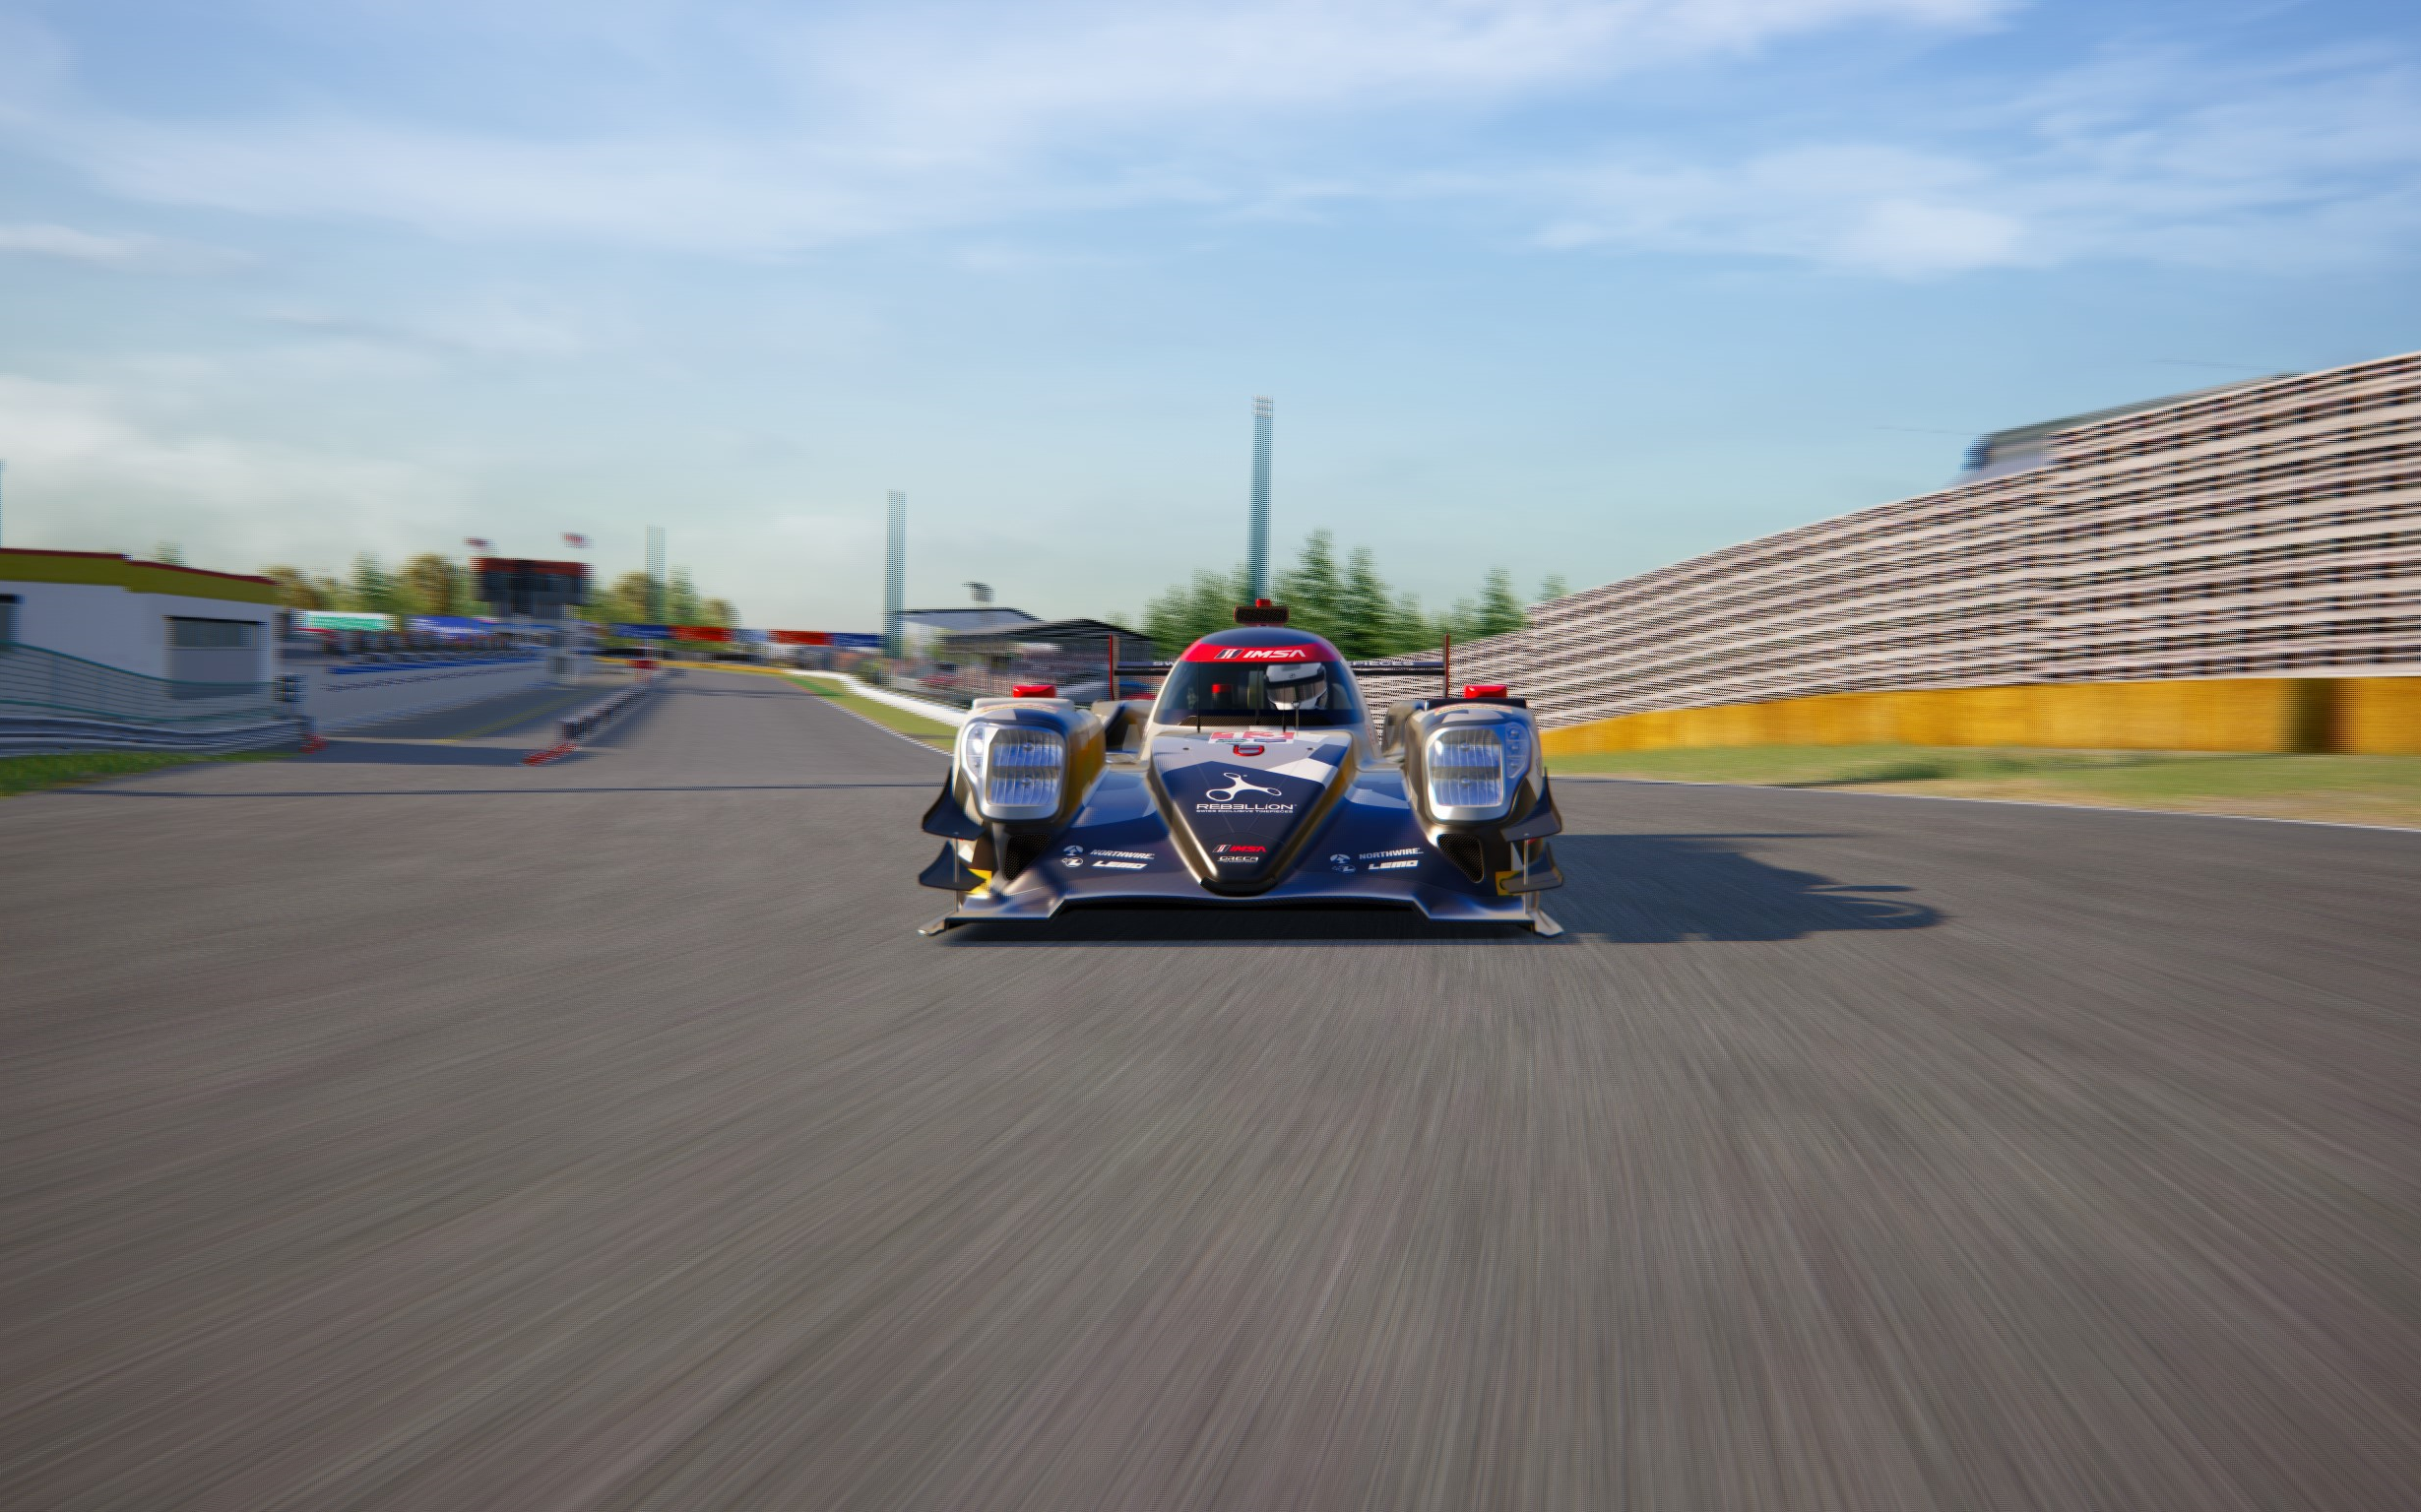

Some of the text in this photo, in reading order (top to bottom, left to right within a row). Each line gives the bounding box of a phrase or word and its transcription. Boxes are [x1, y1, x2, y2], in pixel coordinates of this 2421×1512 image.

[1242, 649, 1306, 659] IMSA
[1090, 849, 1153, 859] NORTHWIRE
[1359, 848, 1421, 859] NORTHWIRE
[1369, 859, 1419, 870] LEMO
